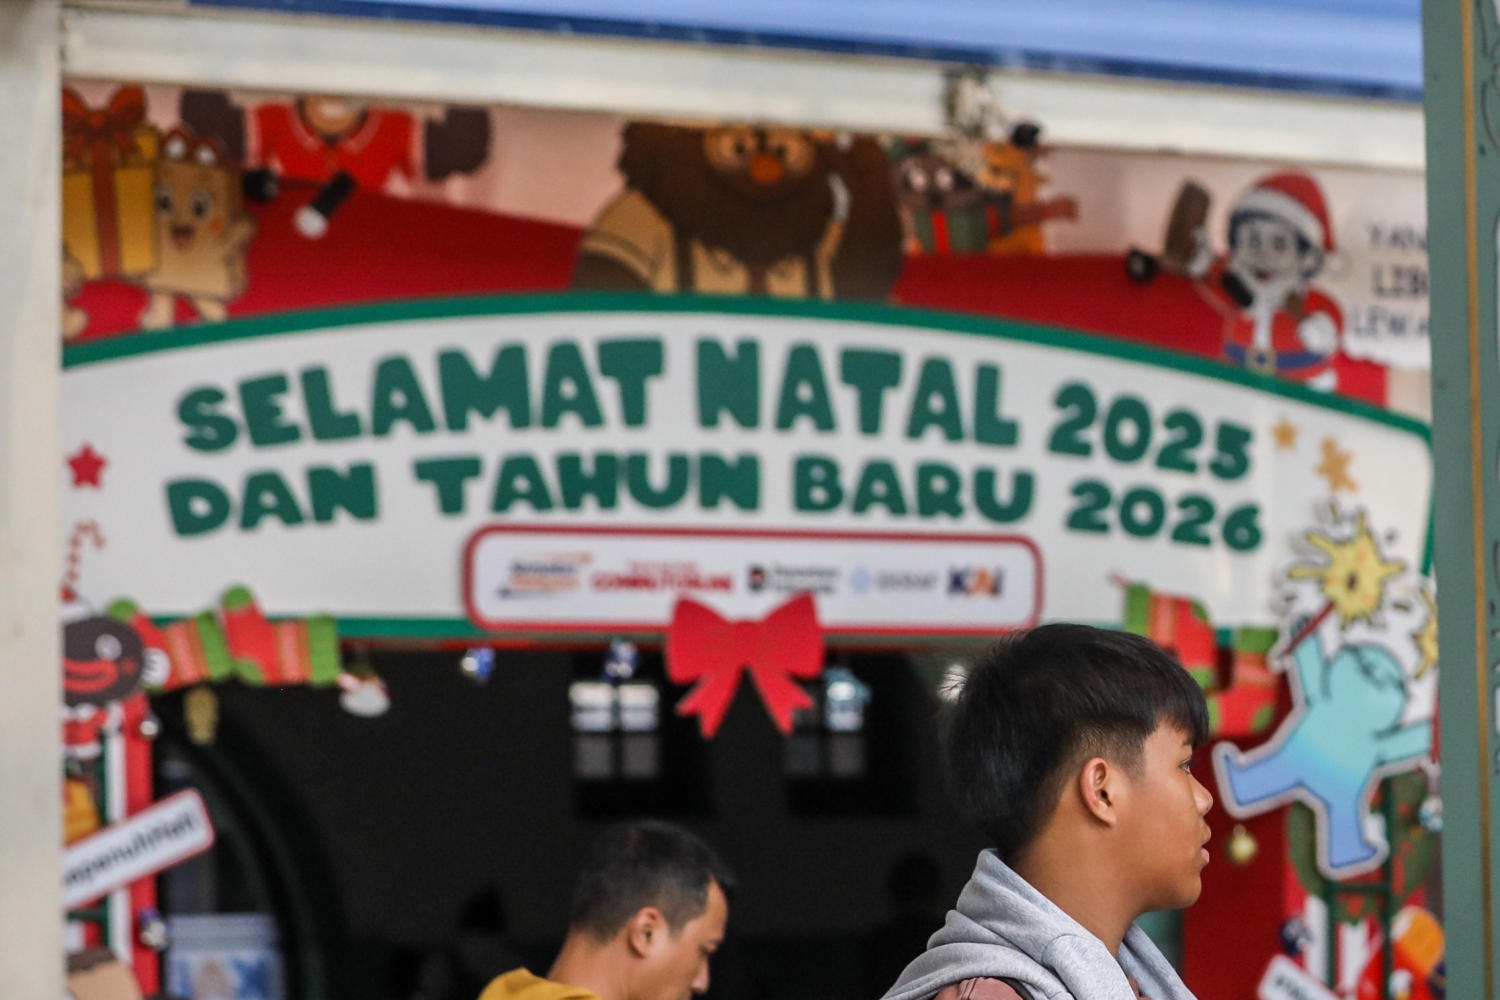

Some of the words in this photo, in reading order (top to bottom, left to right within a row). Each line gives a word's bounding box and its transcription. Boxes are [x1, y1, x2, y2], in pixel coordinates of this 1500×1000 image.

[176, 338, 665, 453] SELAMAT
[696, 338, 1019, 447] NATAL
[1047, 380, 1254, 480] 2025
[165, 462, 377, 537] DAN
[413, 451, 761, 515] TAHUN
[793, 455, 1035, 523] BARU
[1065, 477, 1264, 553] 2026
